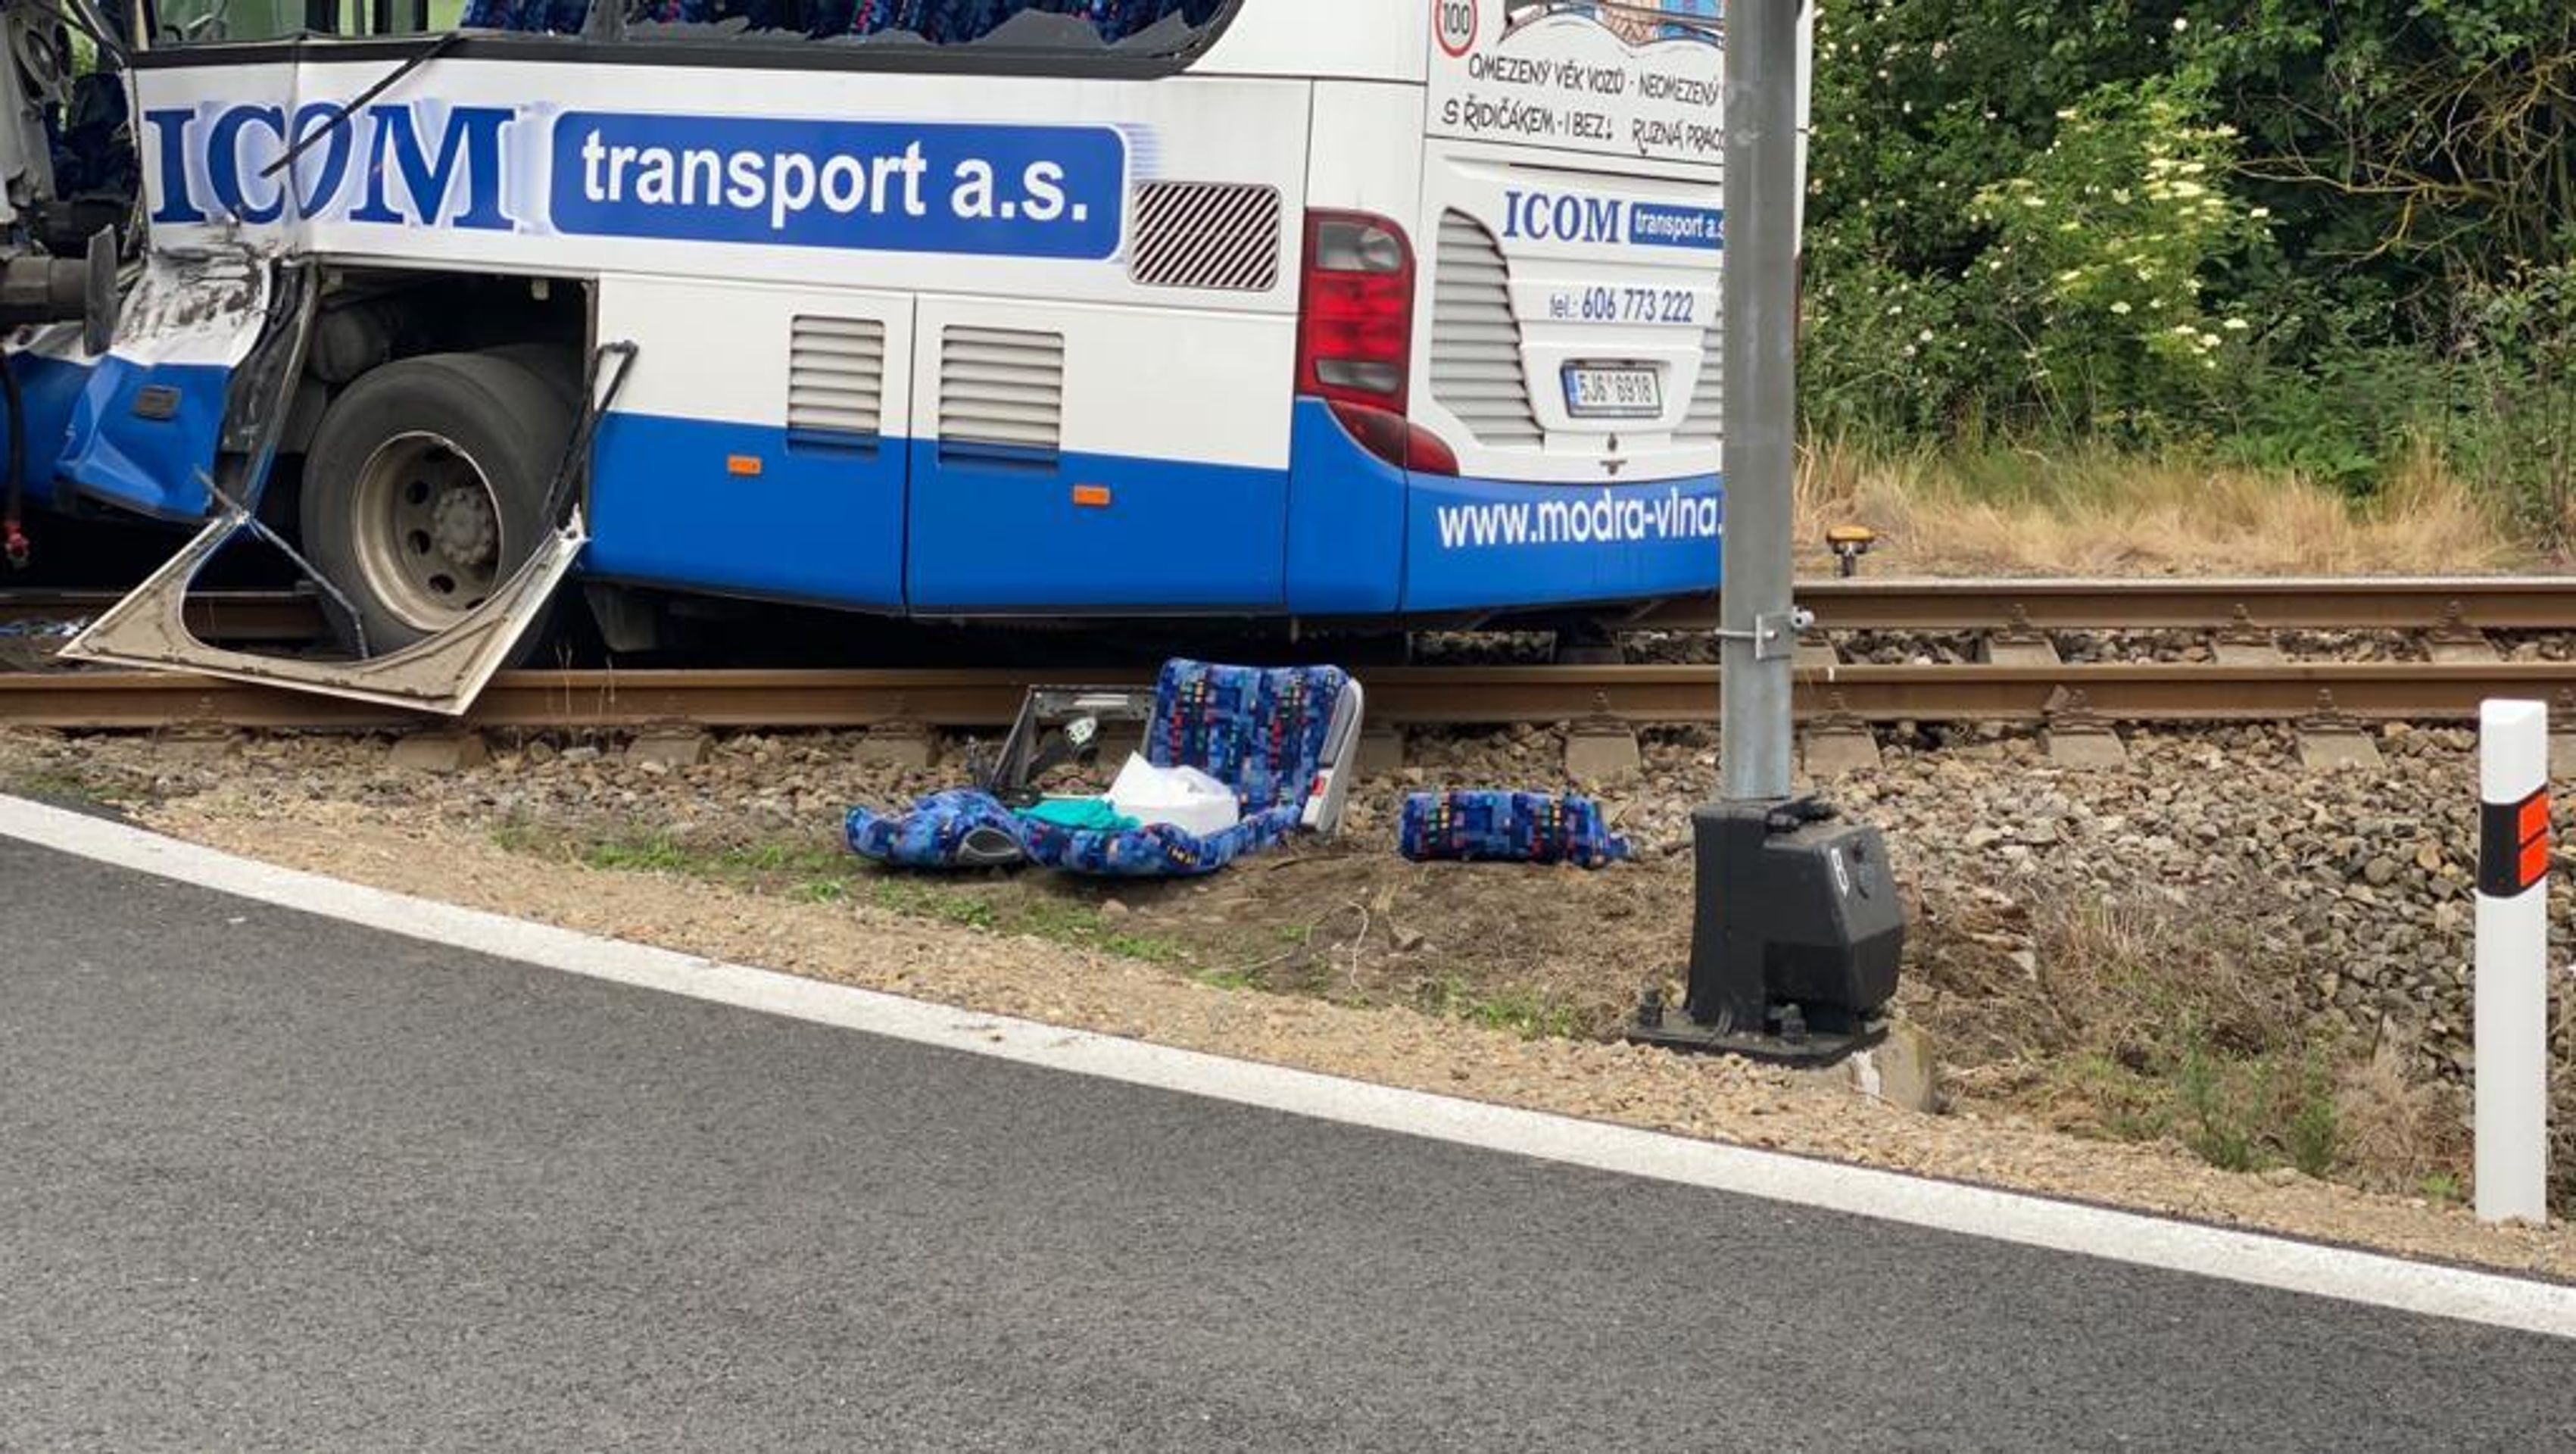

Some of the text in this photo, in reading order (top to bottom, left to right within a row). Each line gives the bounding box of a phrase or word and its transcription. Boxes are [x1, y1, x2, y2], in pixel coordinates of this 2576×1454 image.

[1443, 2, 1470, 35] 100
[1468, 52, 1551, 86] OMEZENÝ
[1441, 98, 1459, 125] S
[144, 101, 1088, 230] ICOM transport a.s.
[1502, 191, 1623, 244] ICOM
[1636, 208, 1704, 242] transport
[1582, 286, 1617, 320] 606
[1623, 289, 1657, 321] 773
[1661, 289, 1694, 323] 222
